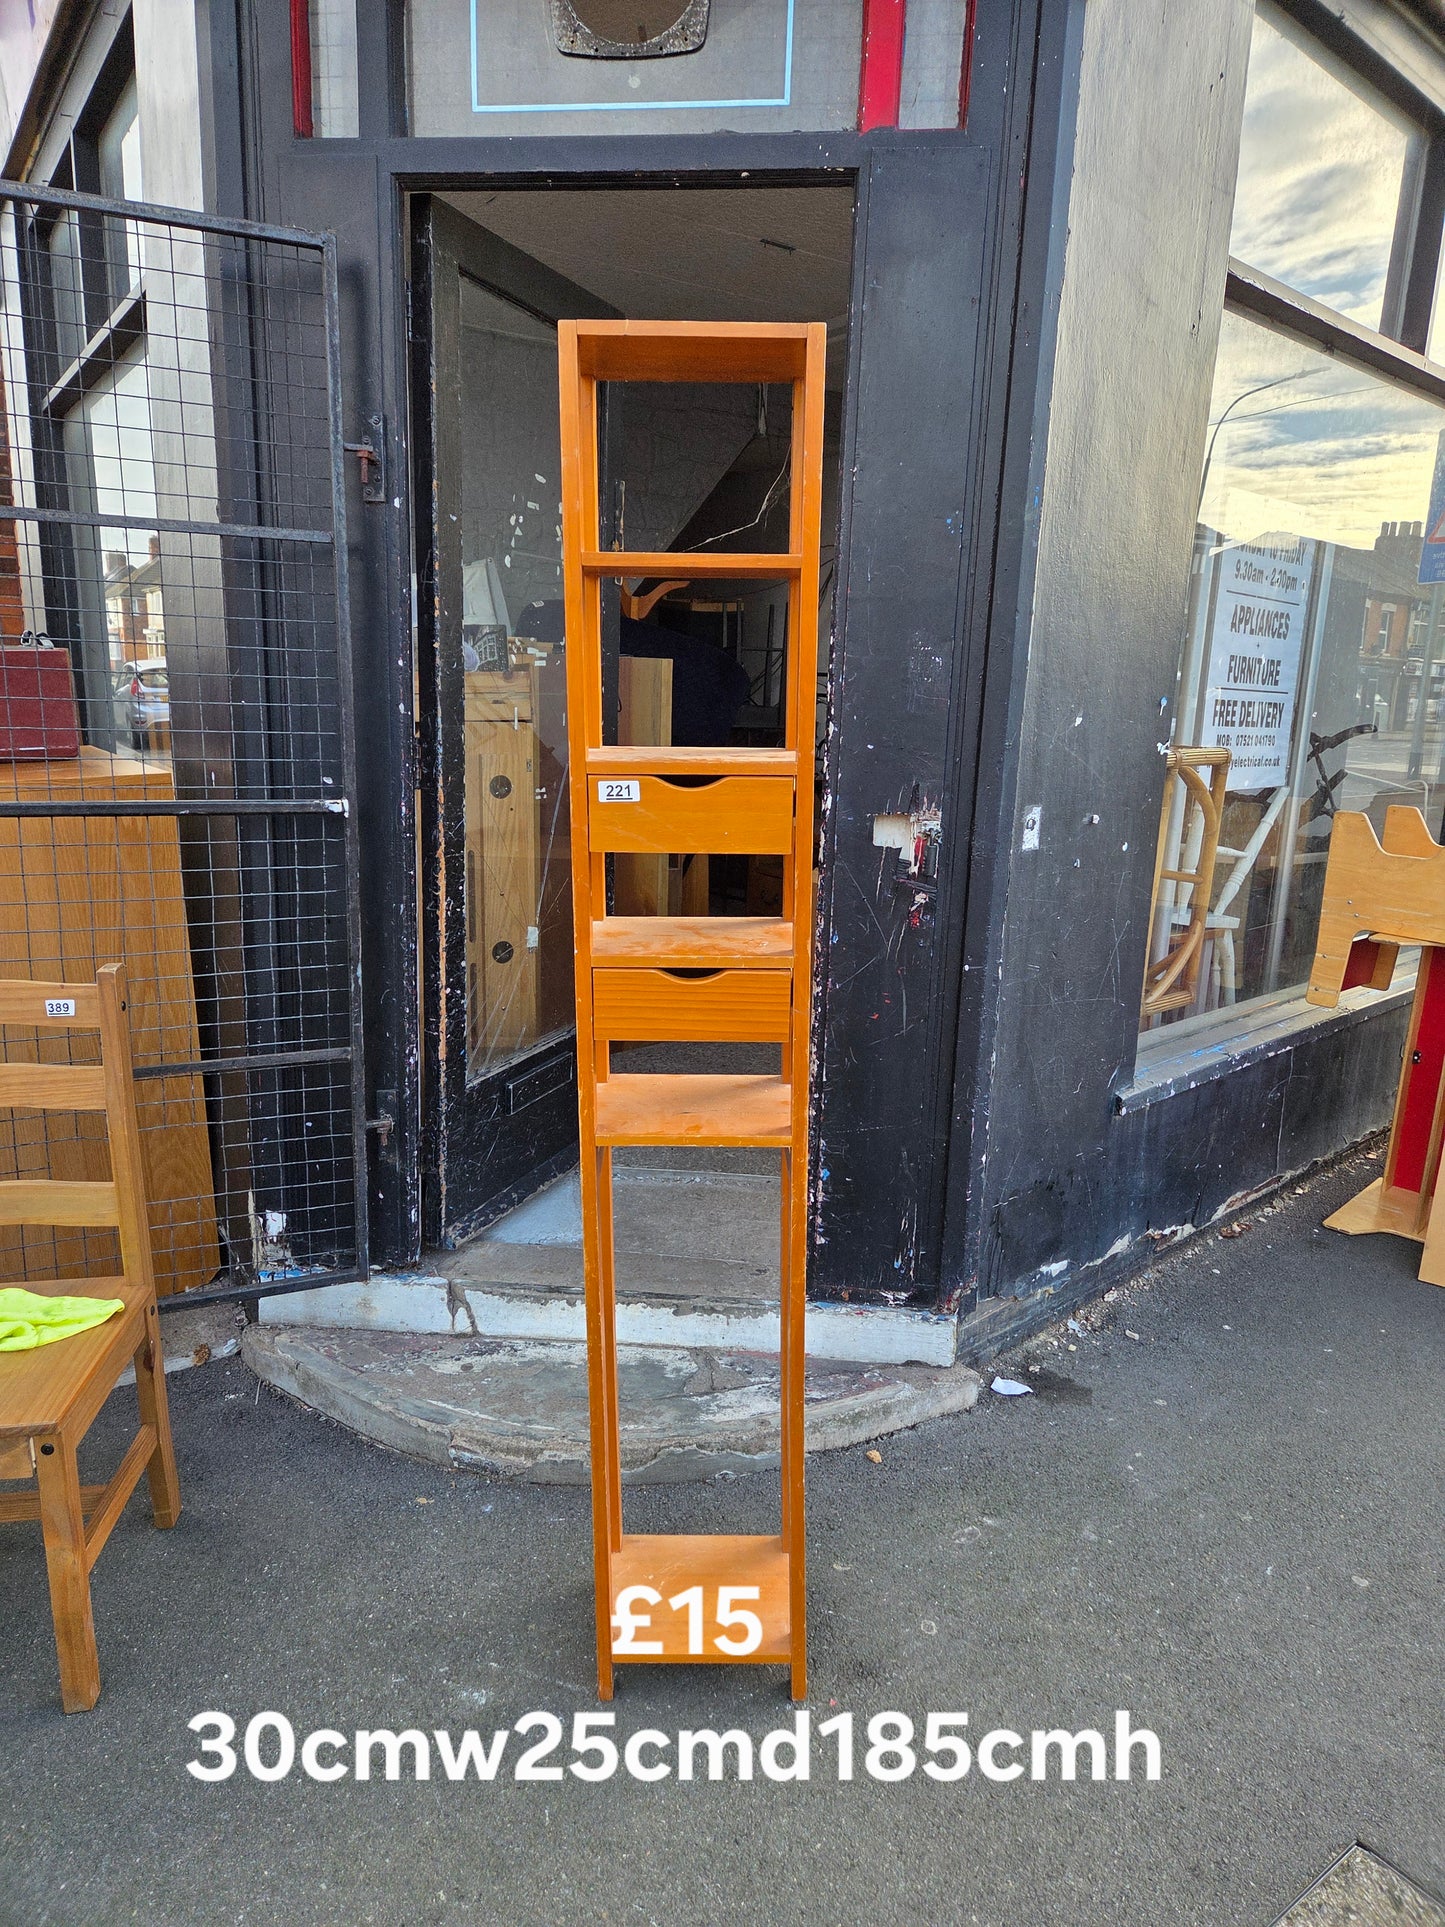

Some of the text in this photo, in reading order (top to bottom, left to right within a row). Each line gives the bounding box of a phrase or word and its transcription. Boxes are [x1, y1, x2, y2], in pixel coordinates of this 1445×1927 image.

[1235, 559, 1264, 584] 9.30am
[1230, 604, 1290, 640] APPLIANCES
[1227, 655, 1281, 686] FURNITURE
[1212, 699, 1284, 728] FREE DELIVERY
[1216, 734, 1232, 746] MOB:
[606, 784, 631, 797] 221
[48, 1003, 69, 1012] 389
